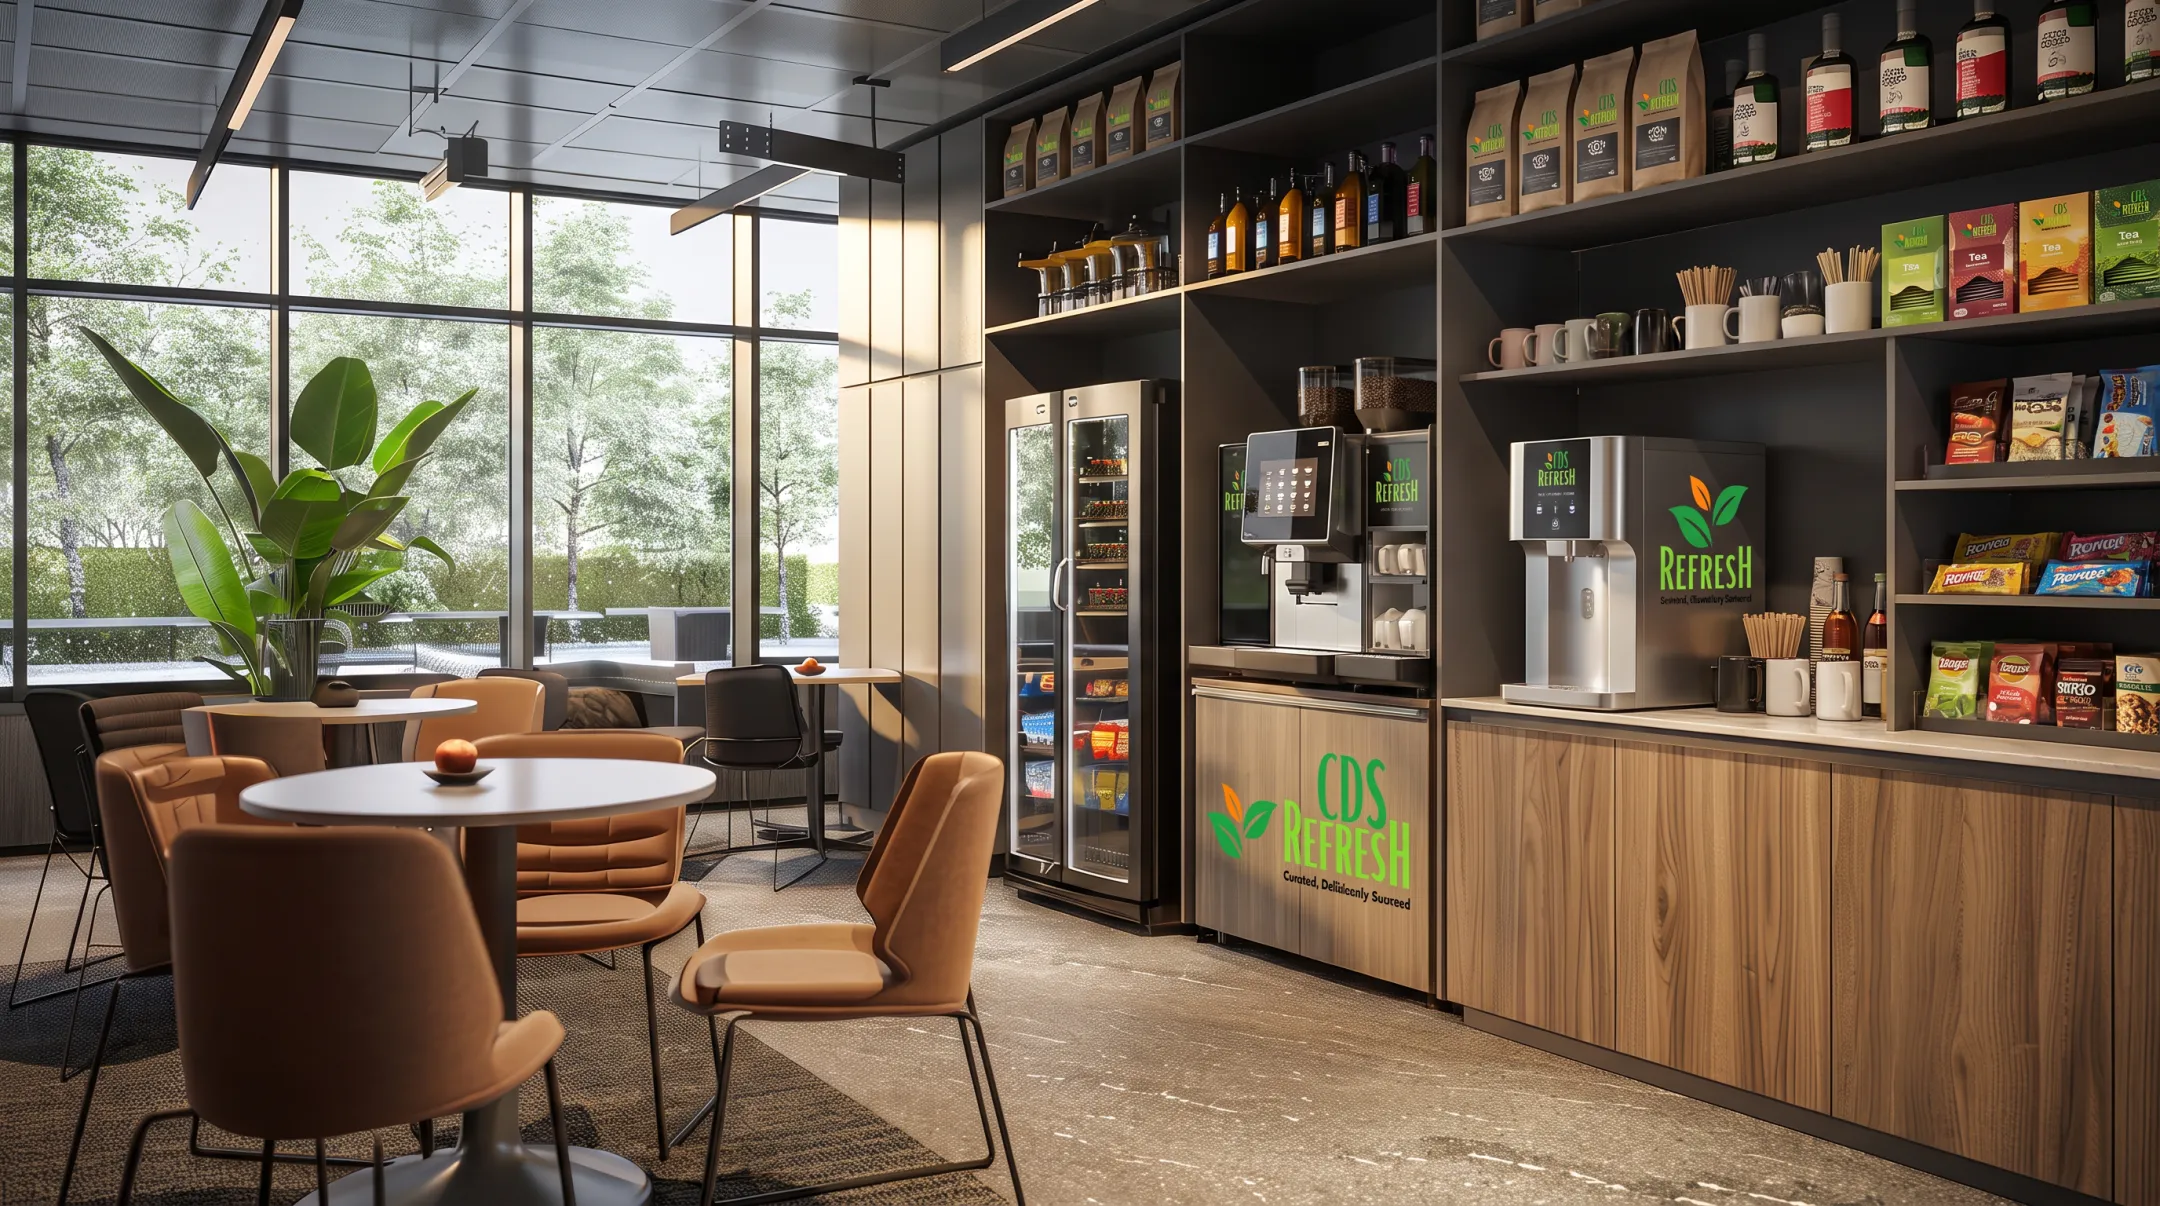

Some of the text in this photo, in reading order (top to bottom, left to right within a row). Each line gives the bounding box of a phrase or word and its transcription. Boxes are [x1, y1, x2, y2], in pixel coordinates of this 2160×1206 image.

[2119, 231, 2140, 241] Tea
[1969, 252, 1988, 262] Tea
[2042, 243, 2061, 253] Tea
[1393, 457, 1411, 482] CDS
[1538, 468, 1576, 487] REFRESH
[1375, 479, 1419, 504] REFRESH
[1660, 544, 1752, 591] REFRESH
[1317, 752, 1387, 830] CDS
[1284, 797, 1410, 890] REFRESH
[1283, 870, 1319, 890] Curated,
